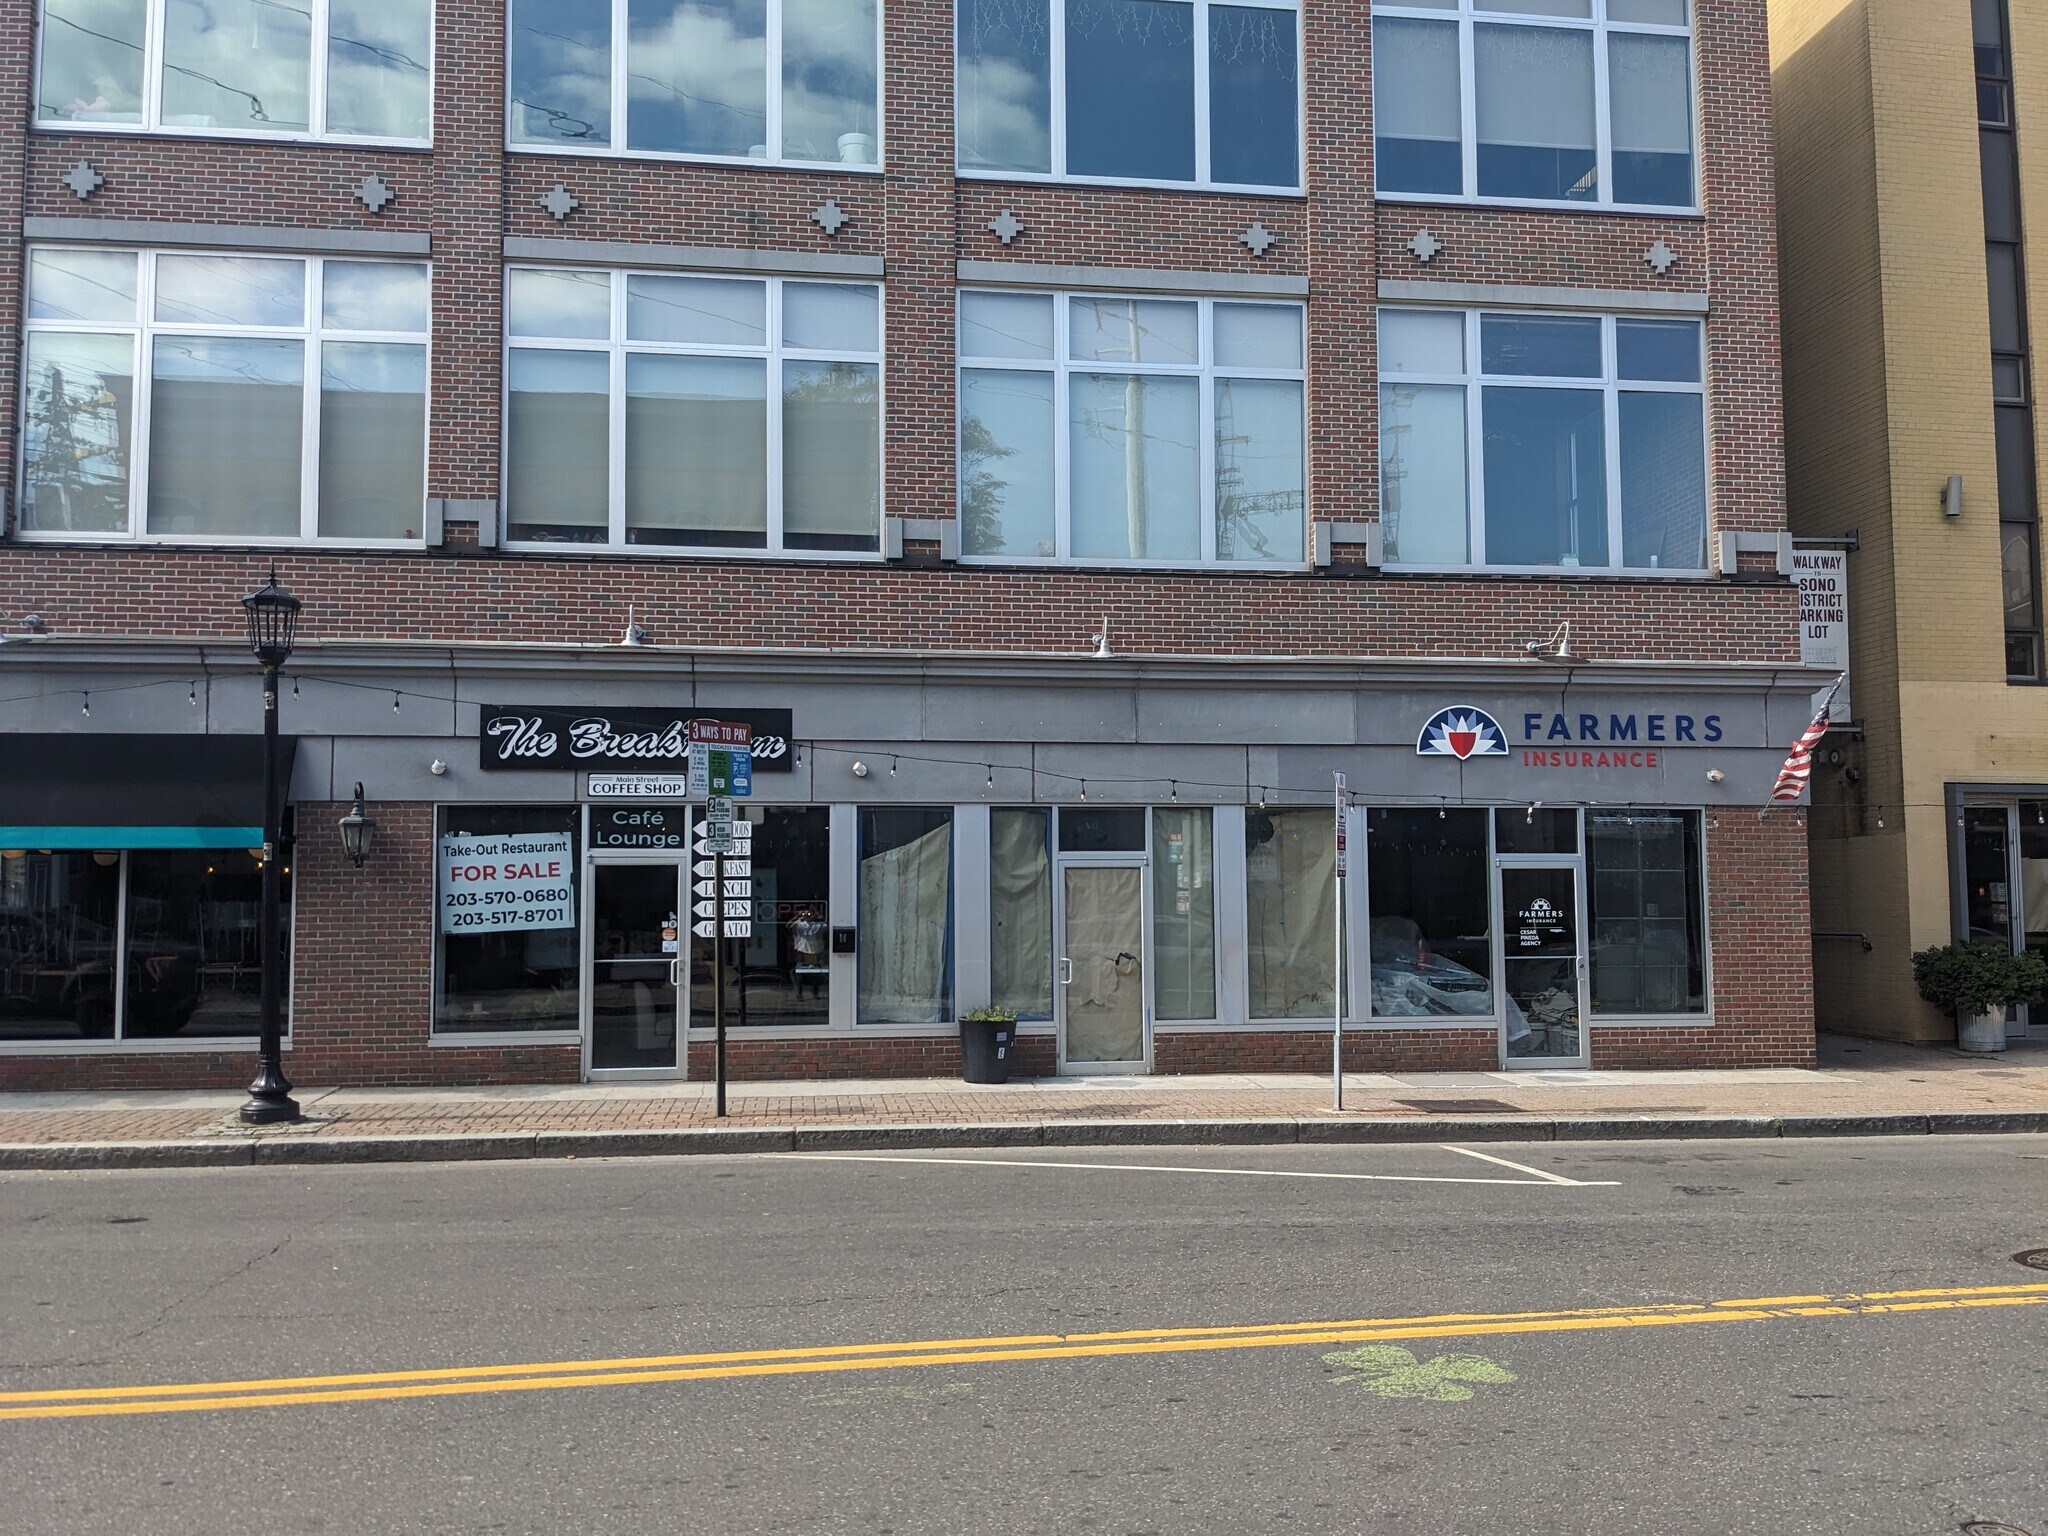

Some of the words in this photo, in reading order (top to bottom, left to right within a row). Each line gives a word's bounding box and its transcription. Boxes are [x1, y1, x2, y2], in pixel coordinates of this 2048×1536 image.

[1793, 556, 1841, 570] WALKWAY
[1800, 578, 1835, 591] SONO
[1800, 594, 1842, 607] ISTRICT
[1800, 609, 1843, 622] ARKING
[1808, 626, 1828, 638] LOT
[692, 722, 699, 739] 3
[700, 725, 719, 739] WAYS
[721, 727, 732, 740] TO
[734, 728, 748, 742] PAY
[1524, 714, 1722, 742] FARMERS
[487, 717, 557, 759] The
[1523, 752, 1658, 768] INSURANCE
[592, 783, 641, 794] COFFEE
[645, 784, 681, 794] SHOP
[709, 800, 715, 812] 2
[612, 810, 664, 825] Café
[709, 824, 715, 836] 3
[597, 831, 680, 848] Lounge
[443, 844, 498, 858] Take-Out
[501, 841, 568, 854] Restaurant
[704, 840, 748, 854] CEE
[451, 865, 497, 882] FOR
[504, 862, 561, 880] SALE
[704, 862, 748, 876] BRKFAST
[446, 888, 568, 907] 203-570-0680
[704, 902, 748, 916] CPES
[1519, 910, 1564, 918] FARMERS
[452, 908, 564, 926] 203-517-8701
[704, 922, 748, 936] GATO
